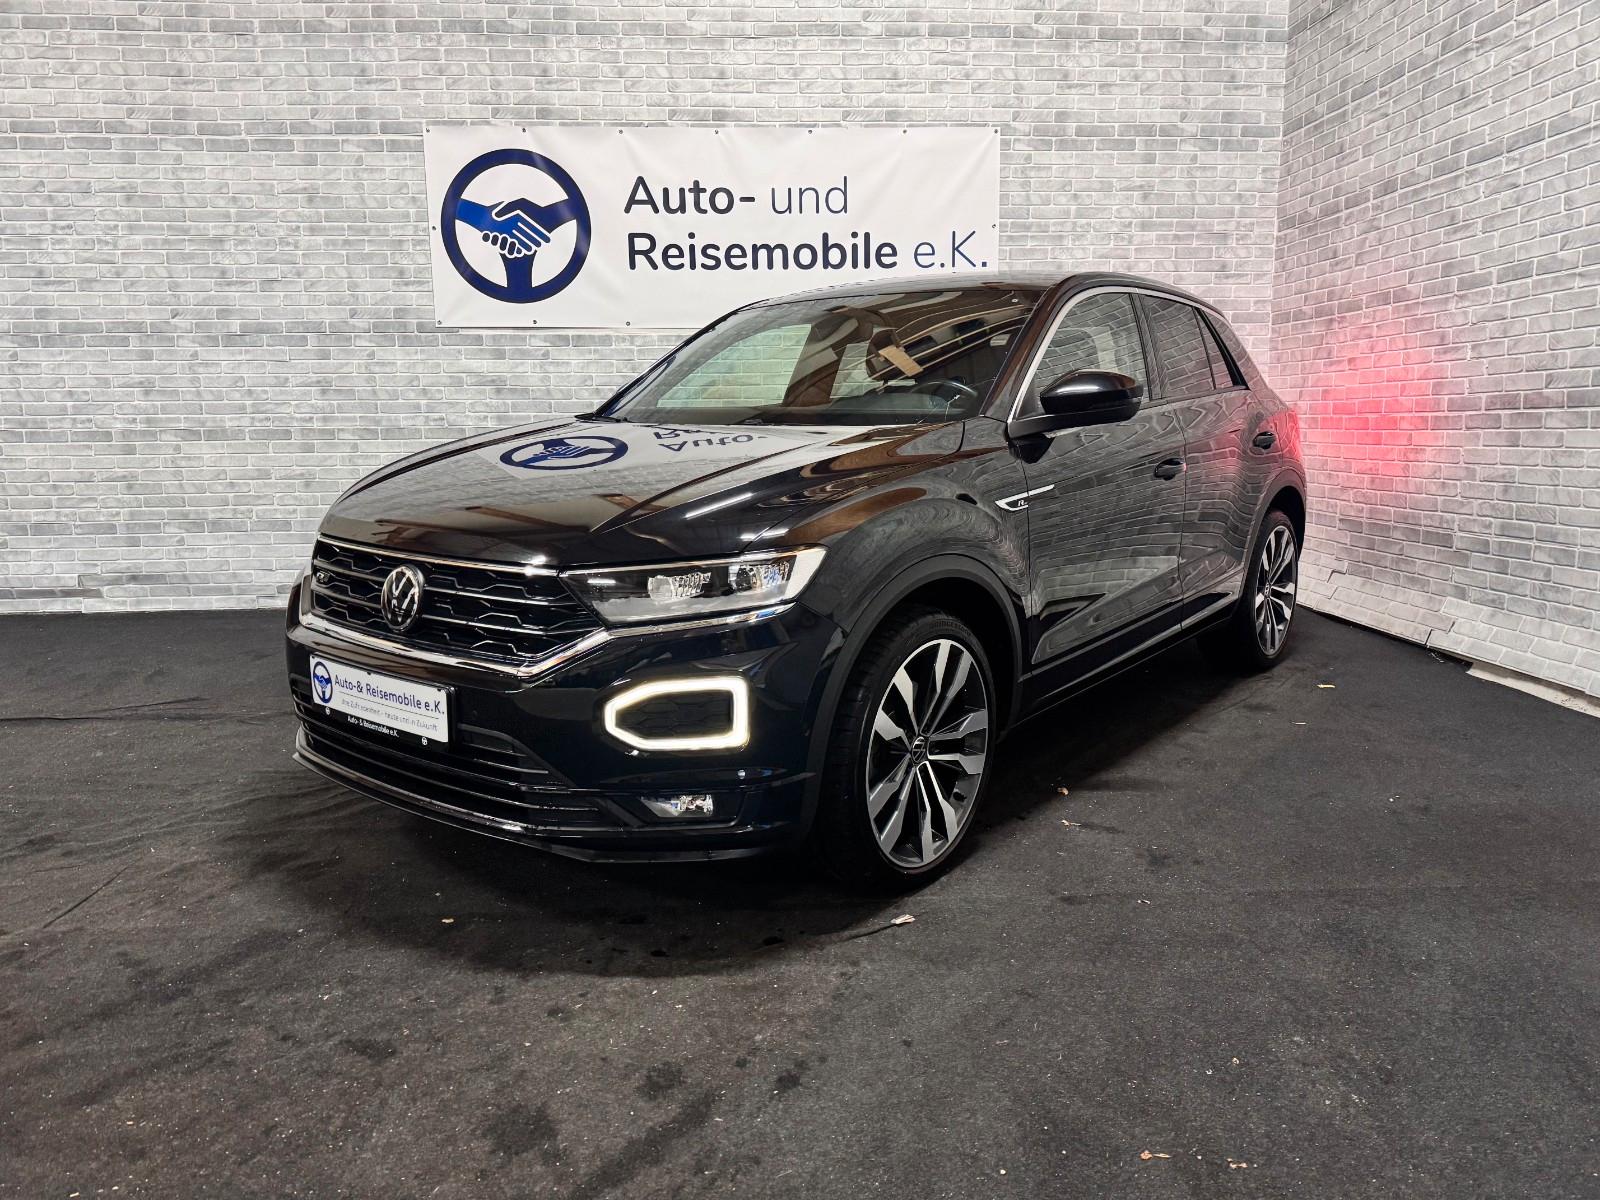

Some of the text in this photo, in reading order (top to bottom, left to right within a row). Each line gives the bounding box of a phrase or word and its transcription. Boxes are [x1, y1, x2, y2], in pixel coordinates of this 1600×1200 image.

[624, 175, 849, 215] Auto- und
[628, 230, 989, 272] Reisemobile e.K.
[366, 683, 422, 710] Reisemobile
[424, 700, 445, 715] e.K.
